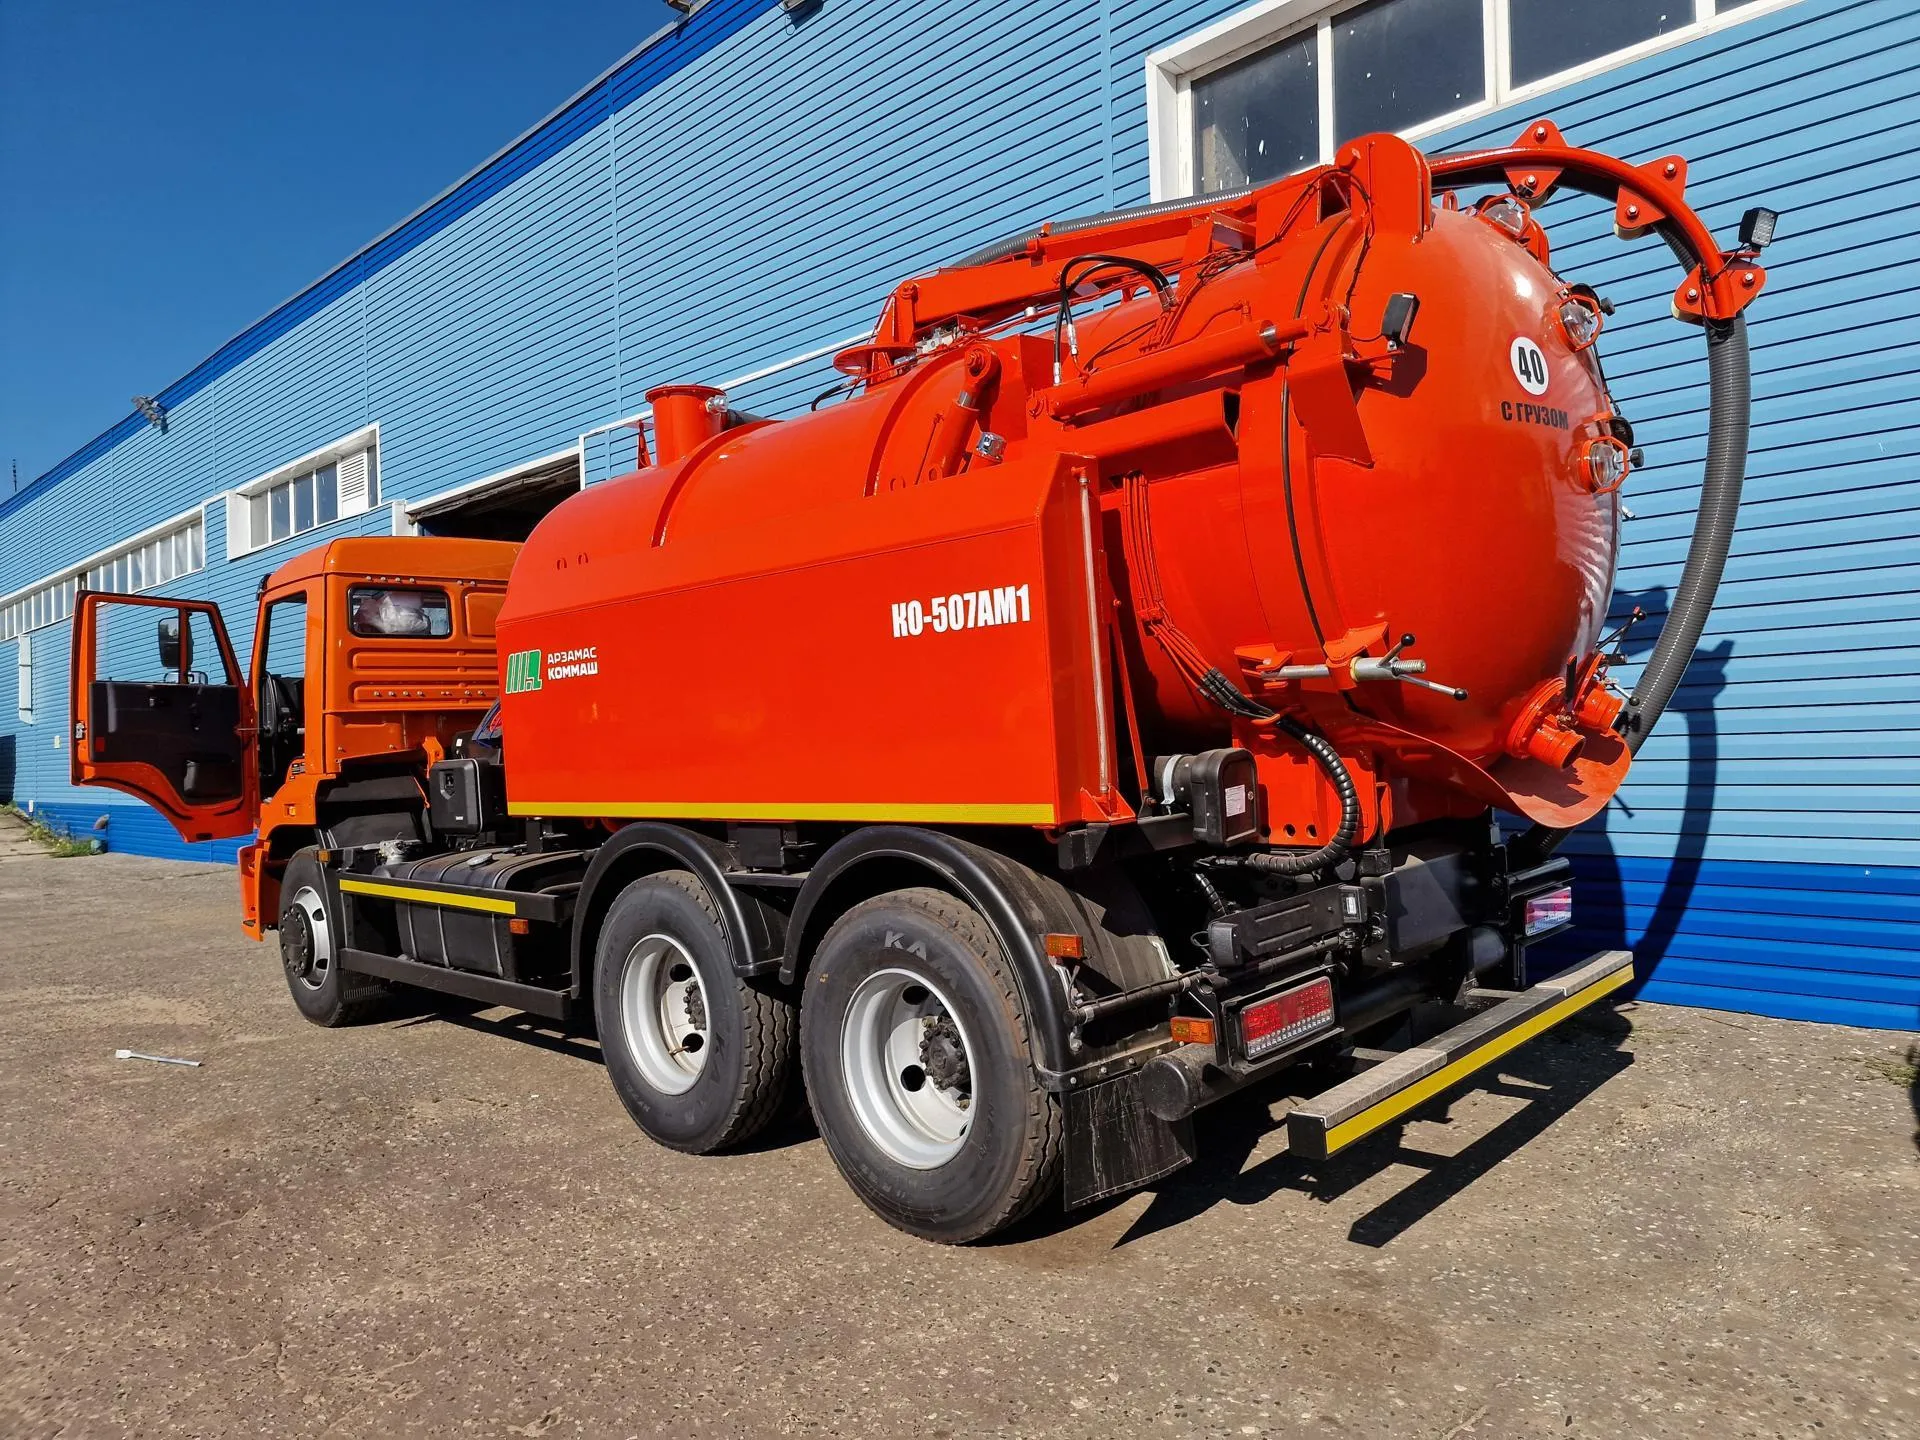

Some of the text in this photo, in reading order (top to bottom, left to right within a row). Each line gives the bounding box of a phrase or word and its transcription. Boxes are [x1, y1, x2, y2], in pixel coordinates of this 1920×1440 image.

[1518, 346, 1545, 385] 40
[1501, 400, 1569, 430] С ГРУЗОМ
[891, 583, 1031, 638] КО-507АМ1
[547, 646, 597, 665] АРЗАМАС
[547, 661, 599, 681] КОММАШ
